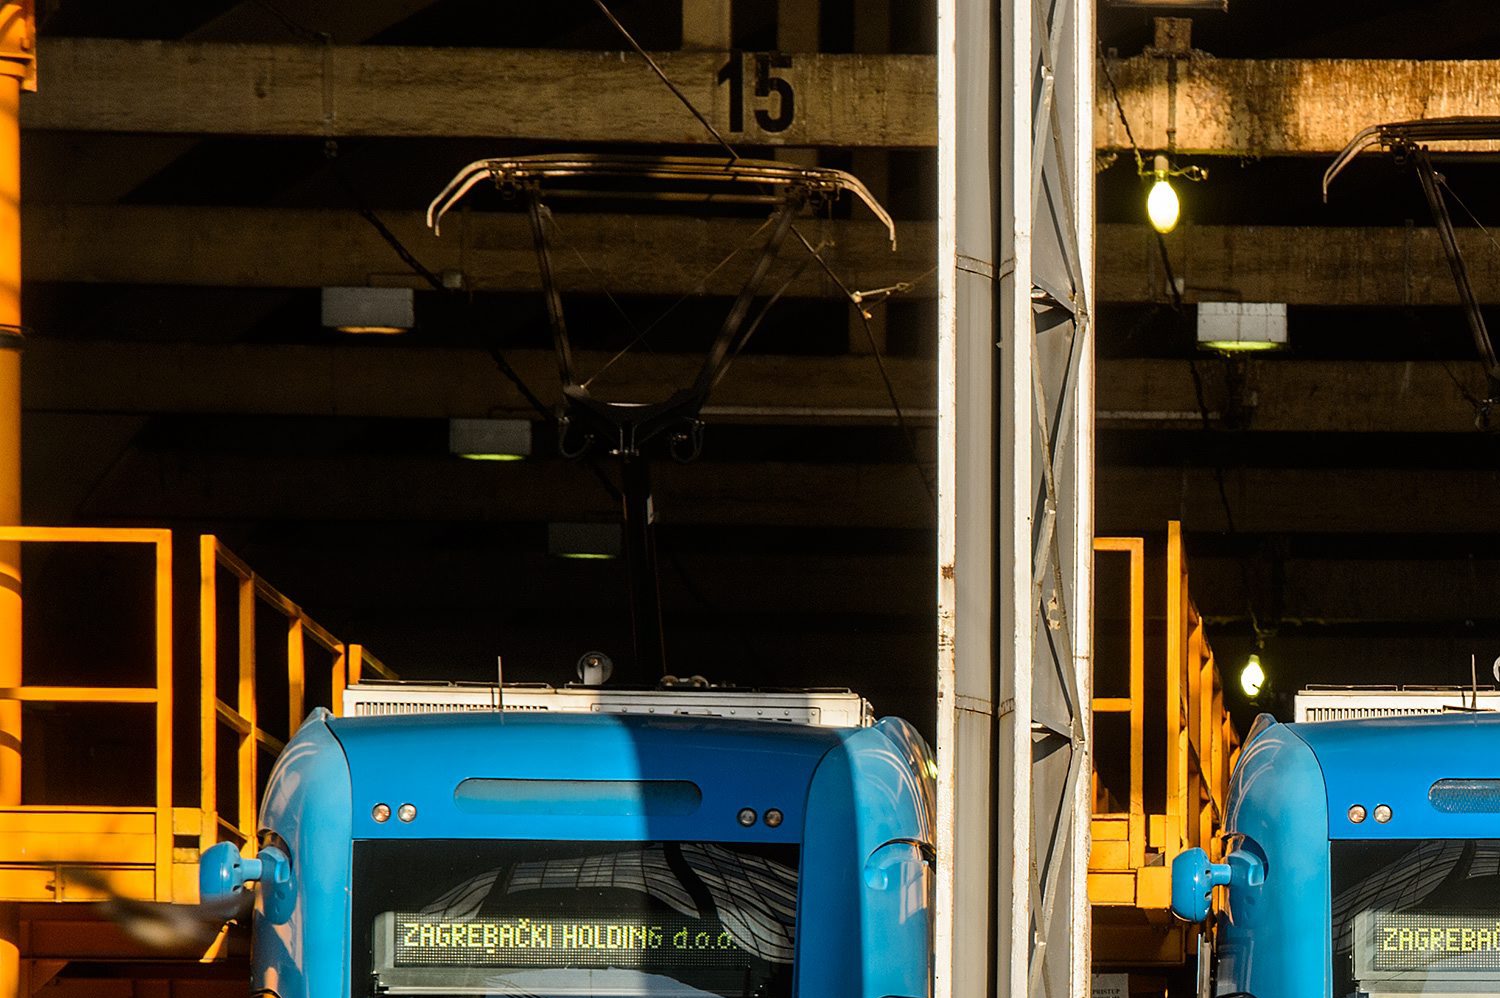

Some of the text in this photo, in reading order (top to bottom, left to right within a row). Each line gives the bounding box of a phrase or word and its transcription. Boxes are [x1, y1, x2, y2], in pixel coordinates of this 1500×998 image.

[717, 51, 795, 133] 15
[403, 918, 552, 949] ZAGREBAČKI
[562, 924, 663, 949] HOLDING
